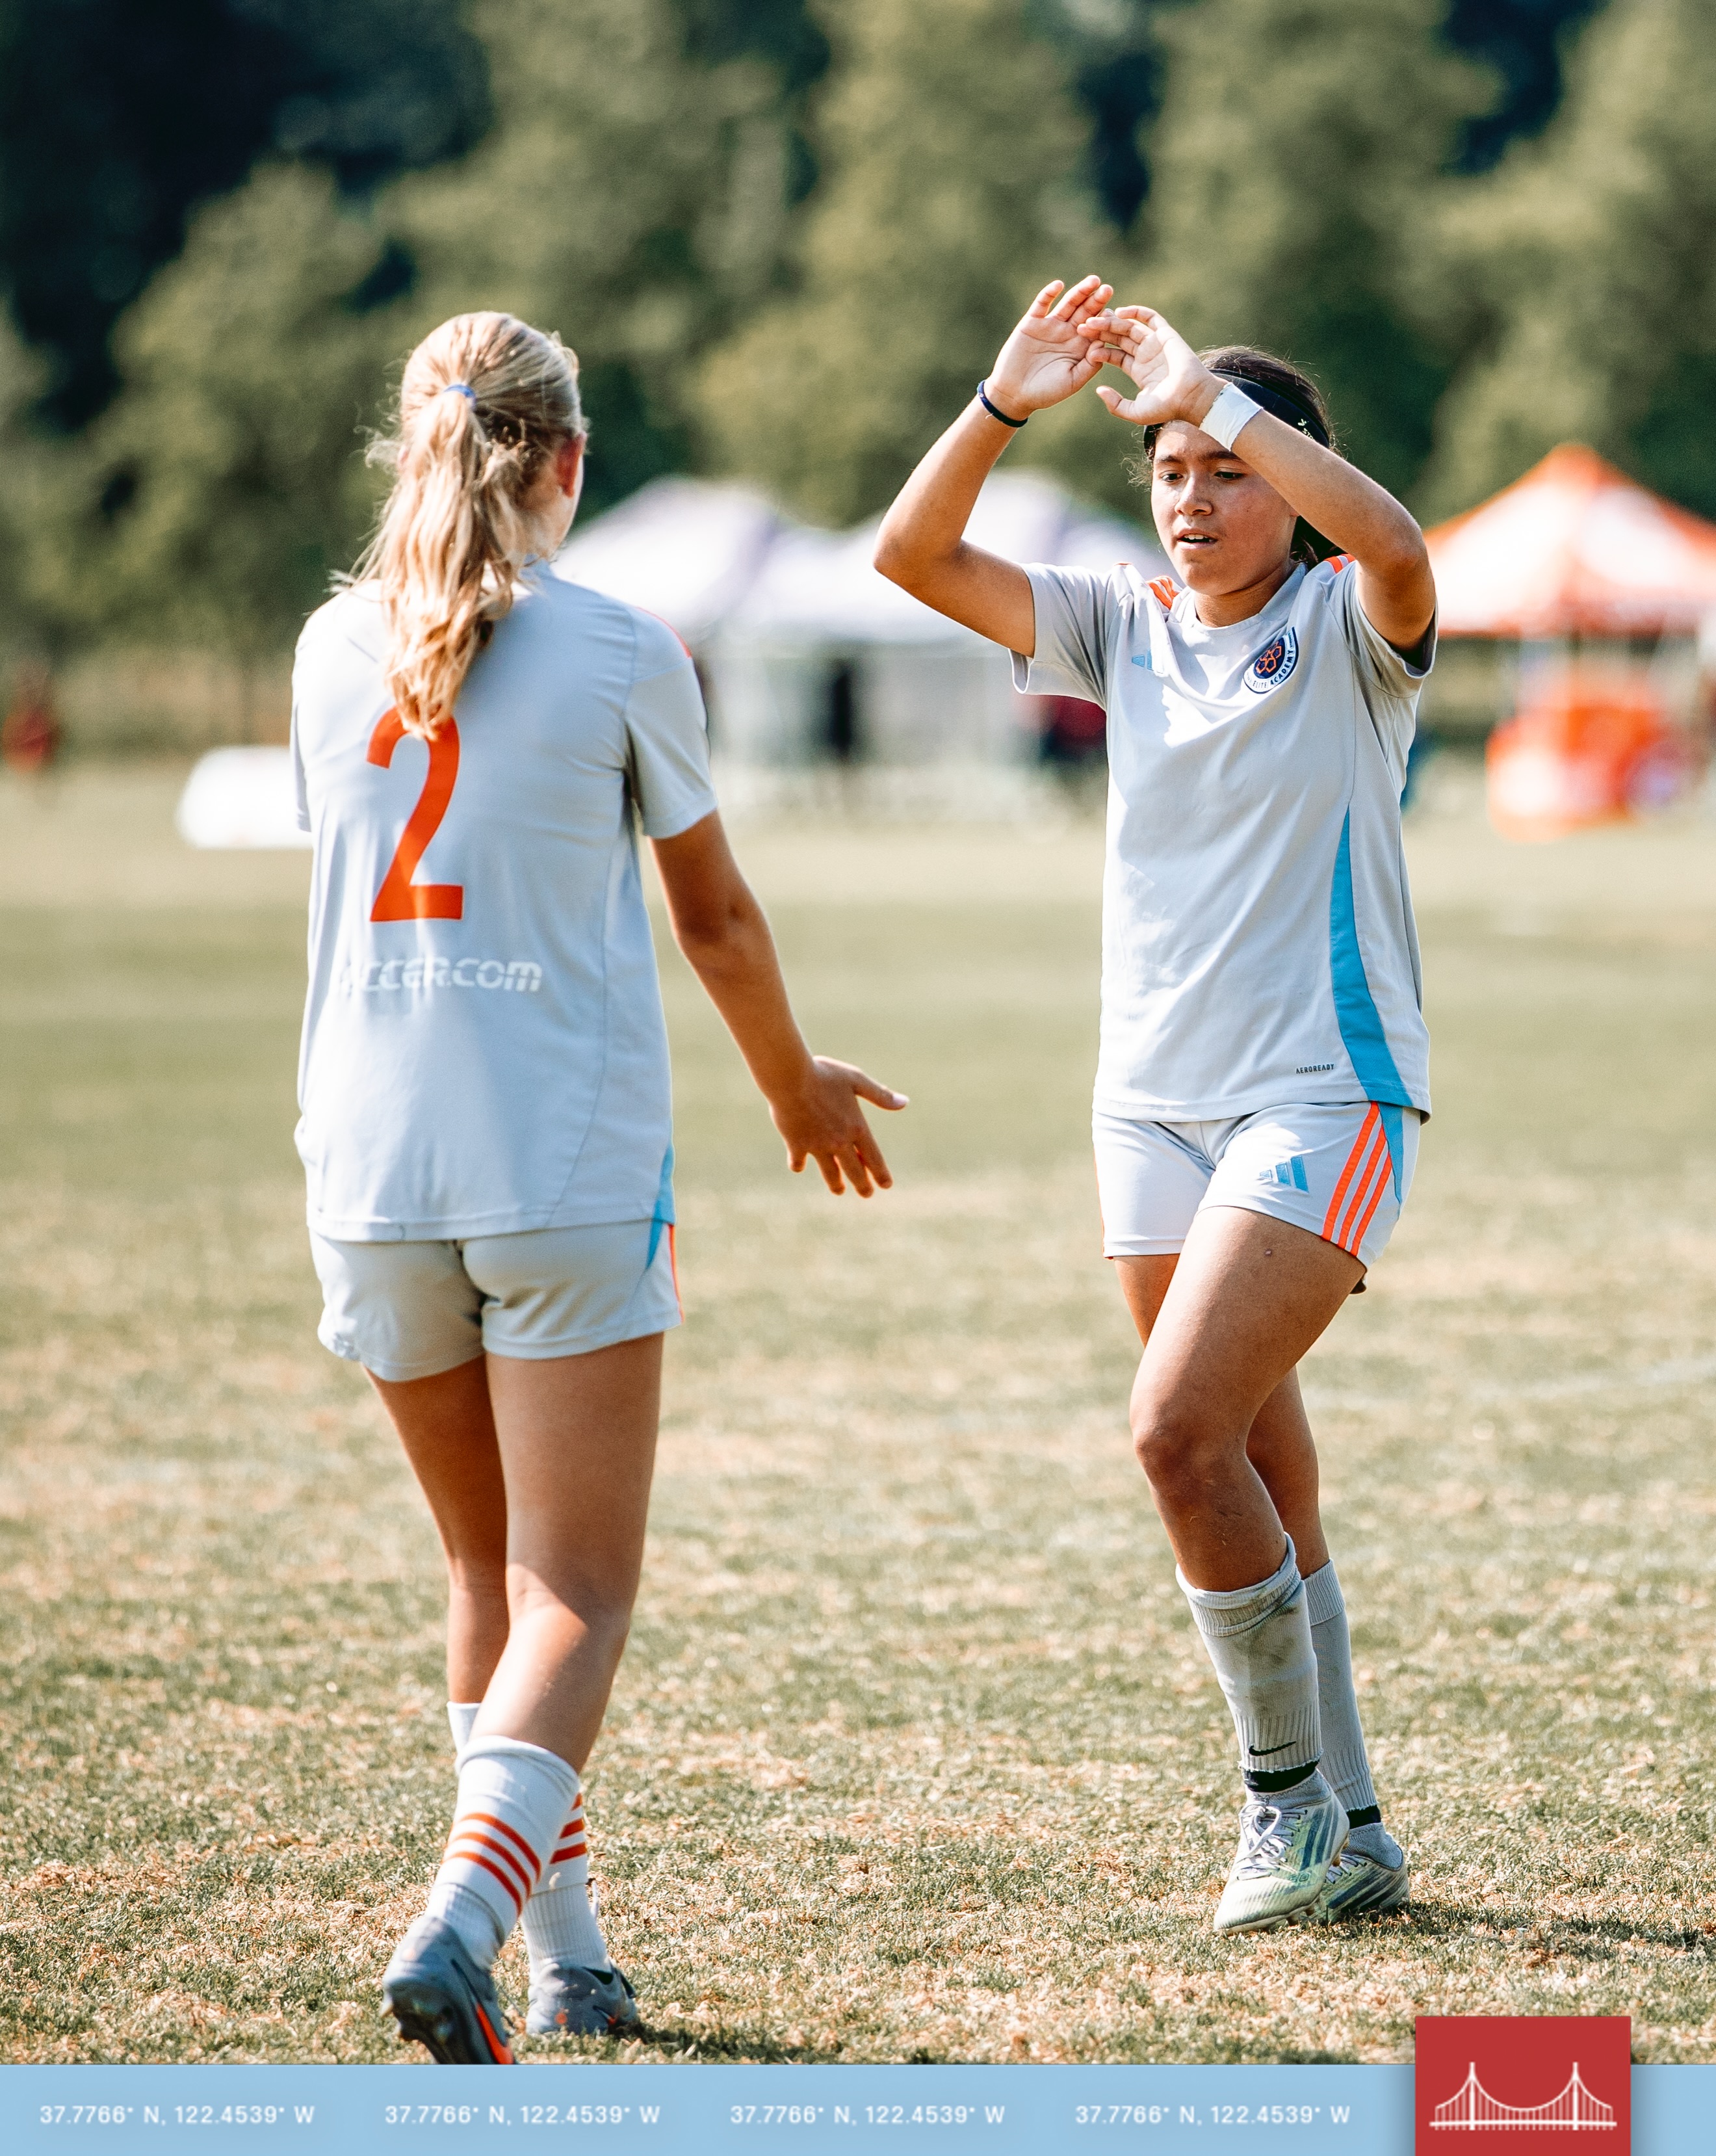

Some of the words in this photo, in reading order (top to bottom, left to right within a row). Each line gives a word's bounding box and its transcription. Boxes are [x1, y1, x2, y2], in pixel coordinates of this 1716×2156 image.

[1270, 649, 1294, 685] ACADEMY
[366, 704, 464, 922] 2
[337, 956, 543, 992] CCER.COM
[1296, 1063, 1334, 1074] AEROREADY
